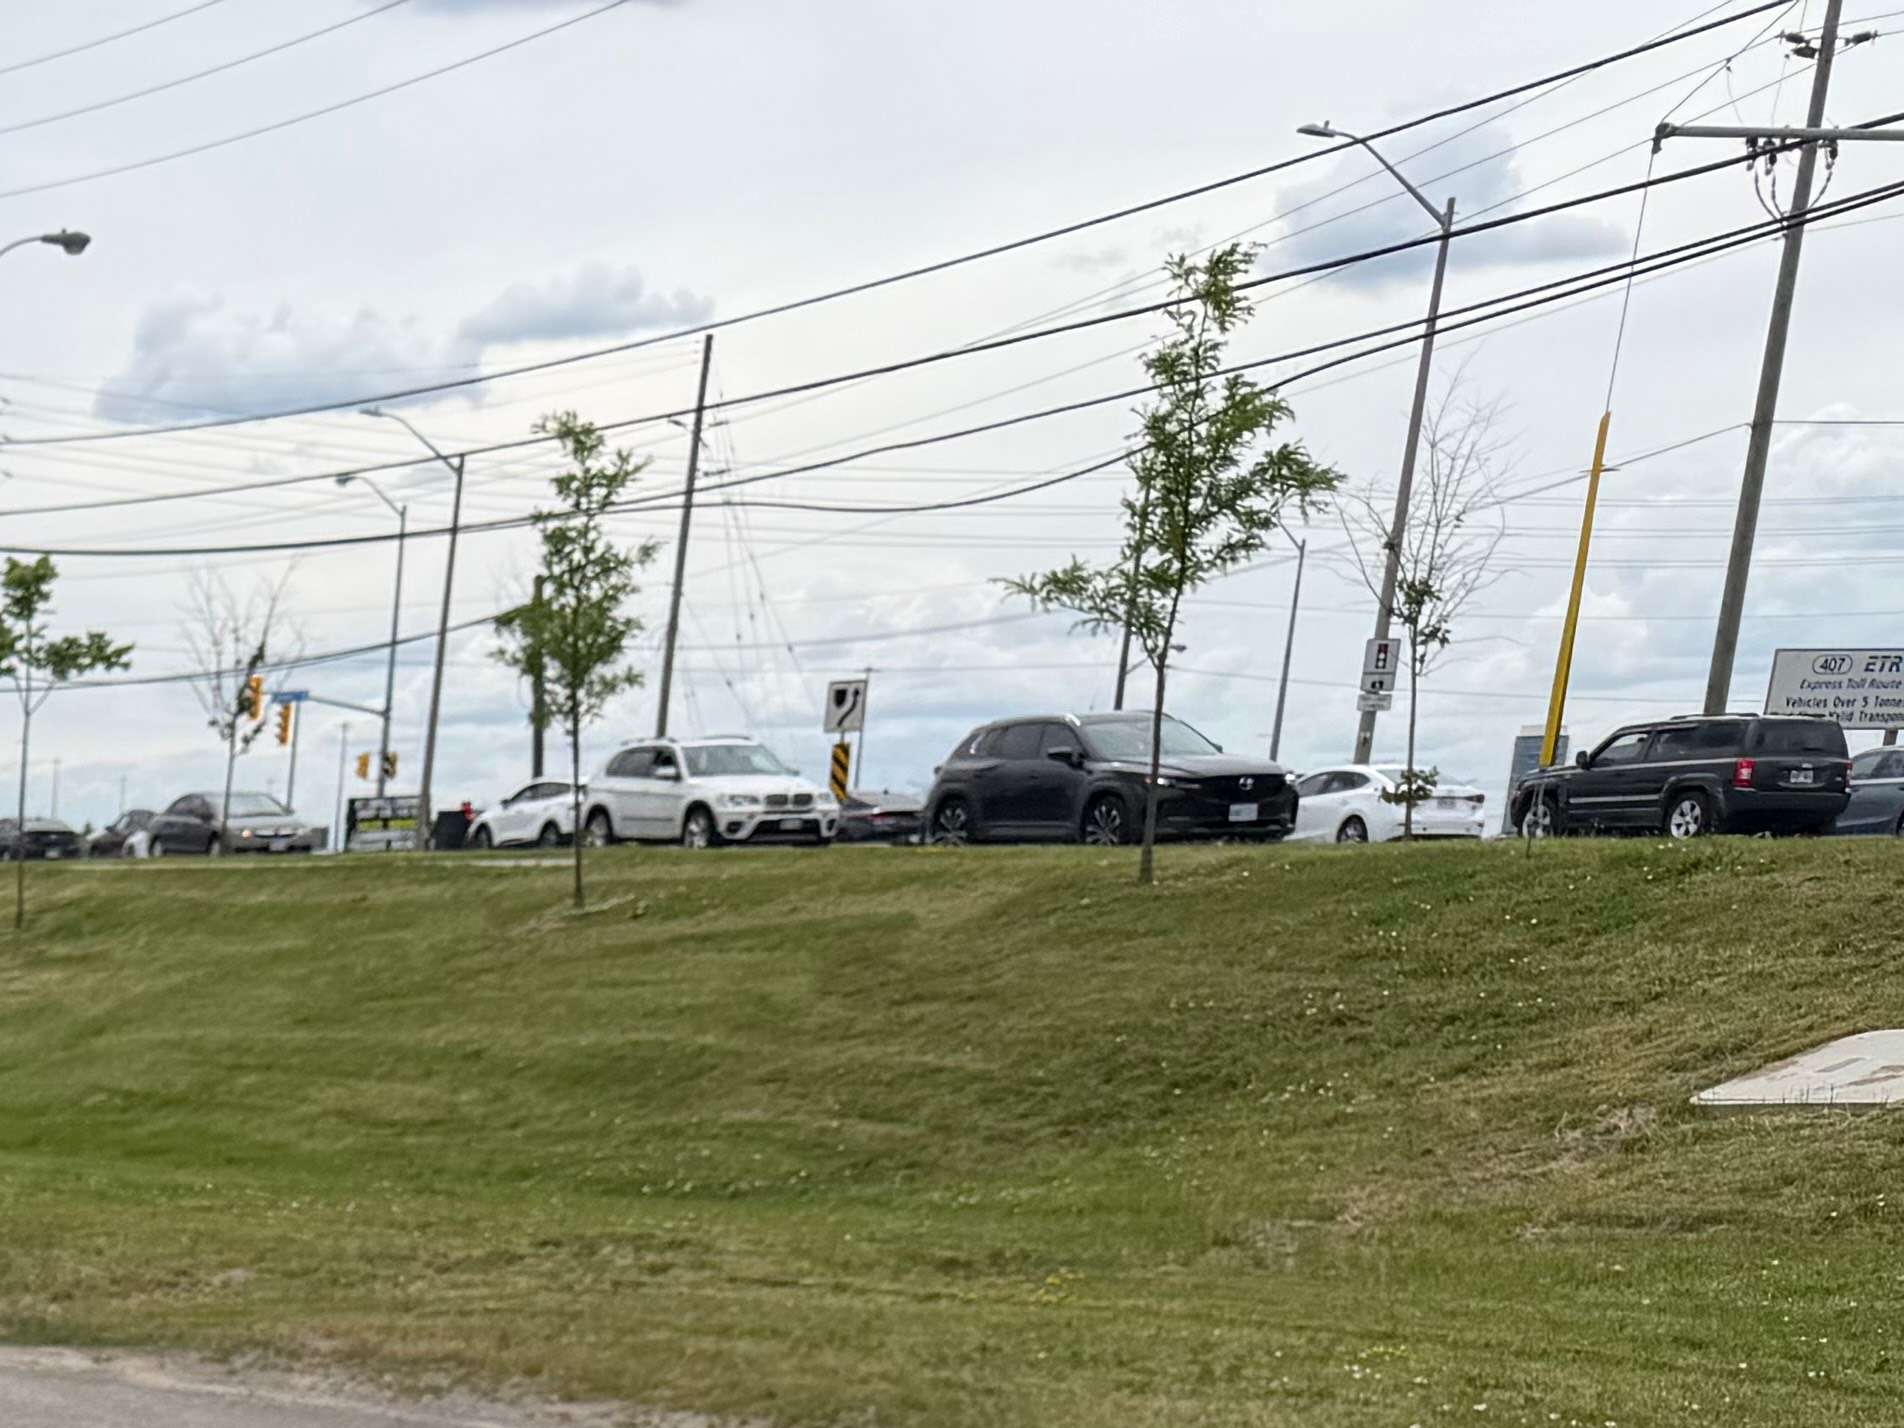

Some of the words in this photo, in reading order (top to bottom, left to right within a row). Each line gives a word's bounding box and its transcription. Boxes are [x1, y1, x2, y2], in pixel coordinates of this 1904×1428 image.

[1819, 657, 1846, 672] 407
[1863, 655, 1903, 672] ETR
[1800, 678, 1842, 690] Express
[1846, 677, 1868, 689] Toll
[1868, 678, 1903, 689] Route
[1786, 696, 1828, 708] Vehicles
[1833, 696, 1857, 708] Over
[1862, 696, 1869, 708] 5
